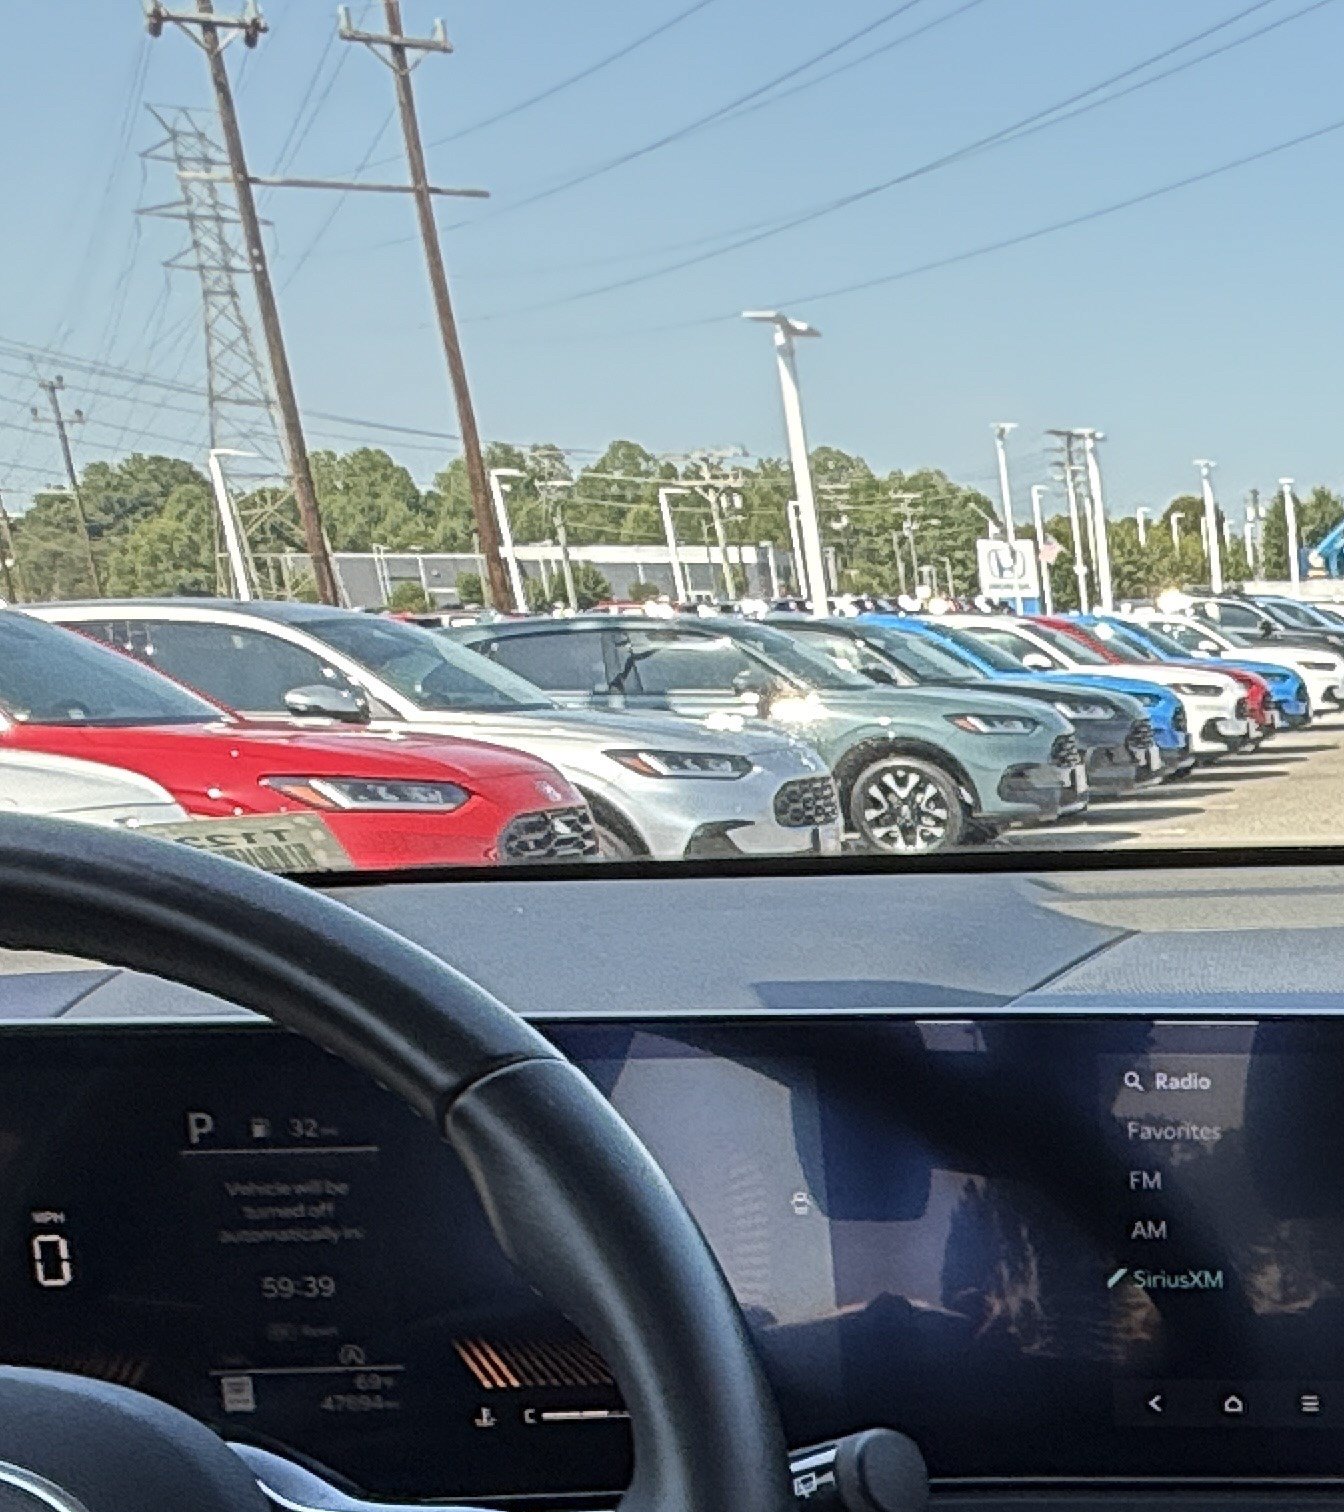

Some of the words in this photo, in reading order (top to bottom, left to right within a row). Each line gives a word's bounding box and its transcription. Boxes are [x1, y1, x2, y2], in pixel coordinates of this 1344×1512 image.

[1155, 1073, 1212, 1091] Radio
[187, 1111, 214, 1145] P
[288, 1117, 318, 1139] 32
[1126, 1121, 1223, 1143] Favorites
[320, 1179, 350, 1196] be
[1128, 1170, 1163, 1191] FM
[30, 1210, 66, 1224] MPH
[1131, 1220, 1168, 1241] AM
[32, 1233, 73, 1288] 0
[260, 1275, 337, 1300] 59:39
[1132, 1268, 1225, 1291] SiriusXM
